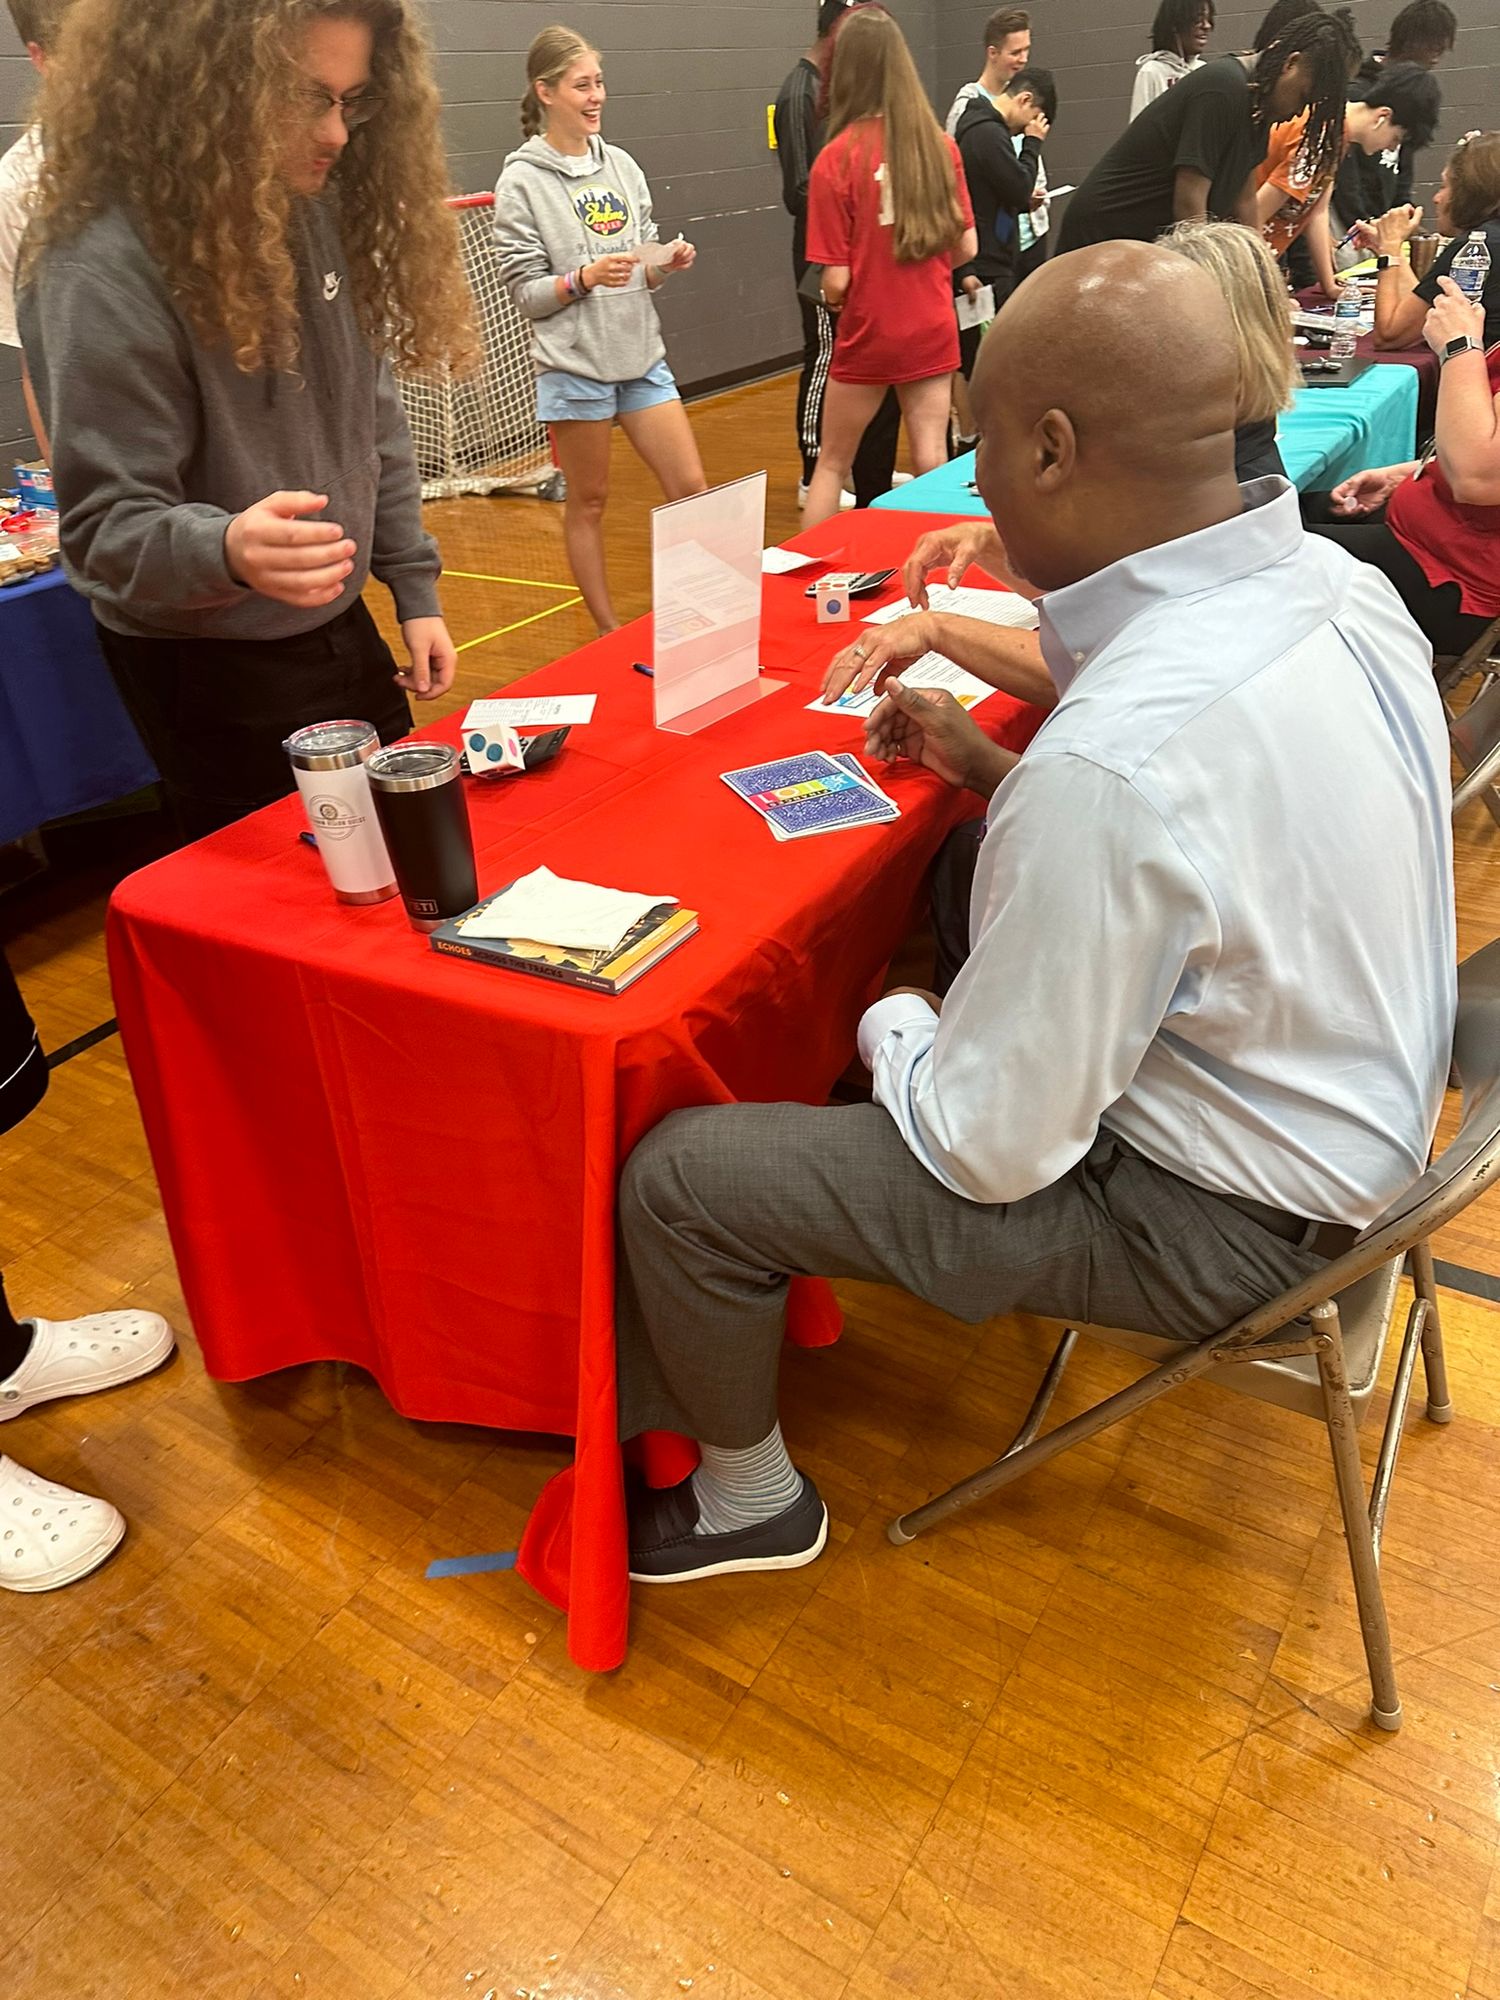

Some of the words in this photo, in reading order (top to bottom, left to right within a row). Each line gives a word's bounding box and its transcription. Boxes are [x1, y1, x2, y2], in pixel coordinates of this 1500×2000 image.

[436, 941, 472, 957] ECHOES
[509, 957, 527, 970] THE
[526, 963, 563, 979] TRACKS
